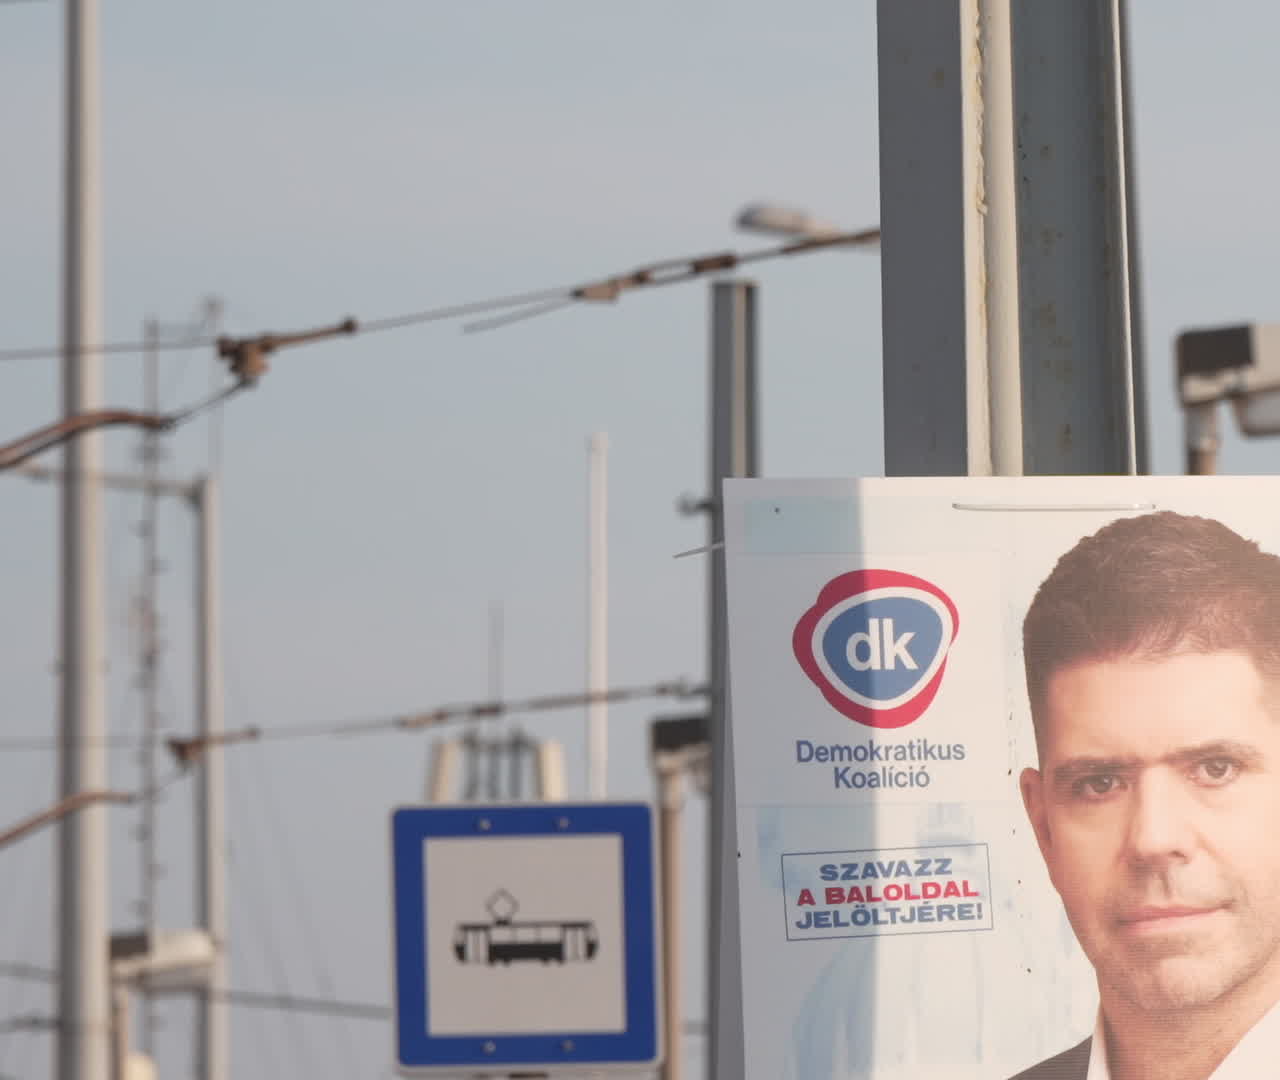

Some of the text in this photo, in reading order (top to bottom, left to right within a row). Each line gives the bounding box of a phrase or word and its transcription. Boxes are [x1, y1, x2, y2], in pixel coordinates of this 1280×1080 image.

[846, 617, 920, 672] dk
[795, 738, 966, 764] Demokratikus
[833, 765, 931, 789] Koalíció
[818, 857, 953, 882] SZAVAZZ
[796, 879, 981, 907] A BALOLDAL
[794, 901, 984, 930] JELÖLTJÉRE!
